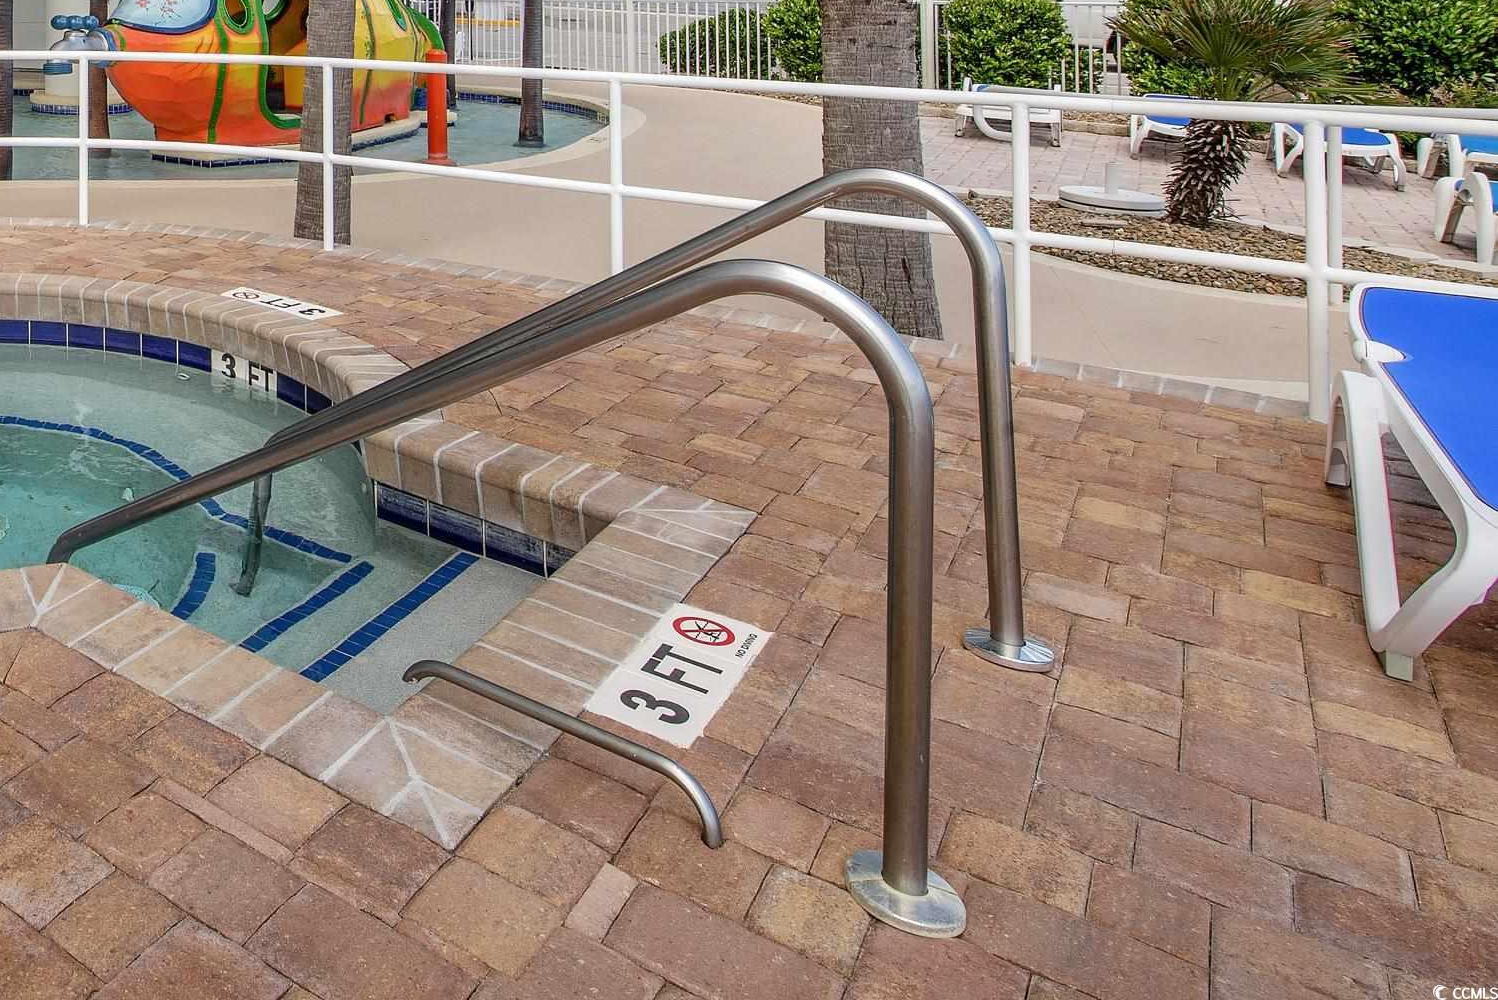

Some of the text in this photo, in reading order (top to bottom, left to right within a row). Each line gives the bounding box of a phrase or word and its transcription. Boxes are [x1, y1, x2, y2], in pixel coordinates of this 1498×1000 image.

[260, 298, 326, 316] 3 FT
[222, 353, 274, 392] 3 FT
[735, 633, 758, 658] NO DIVING
[620, 643, 724, 725] 3 FT
